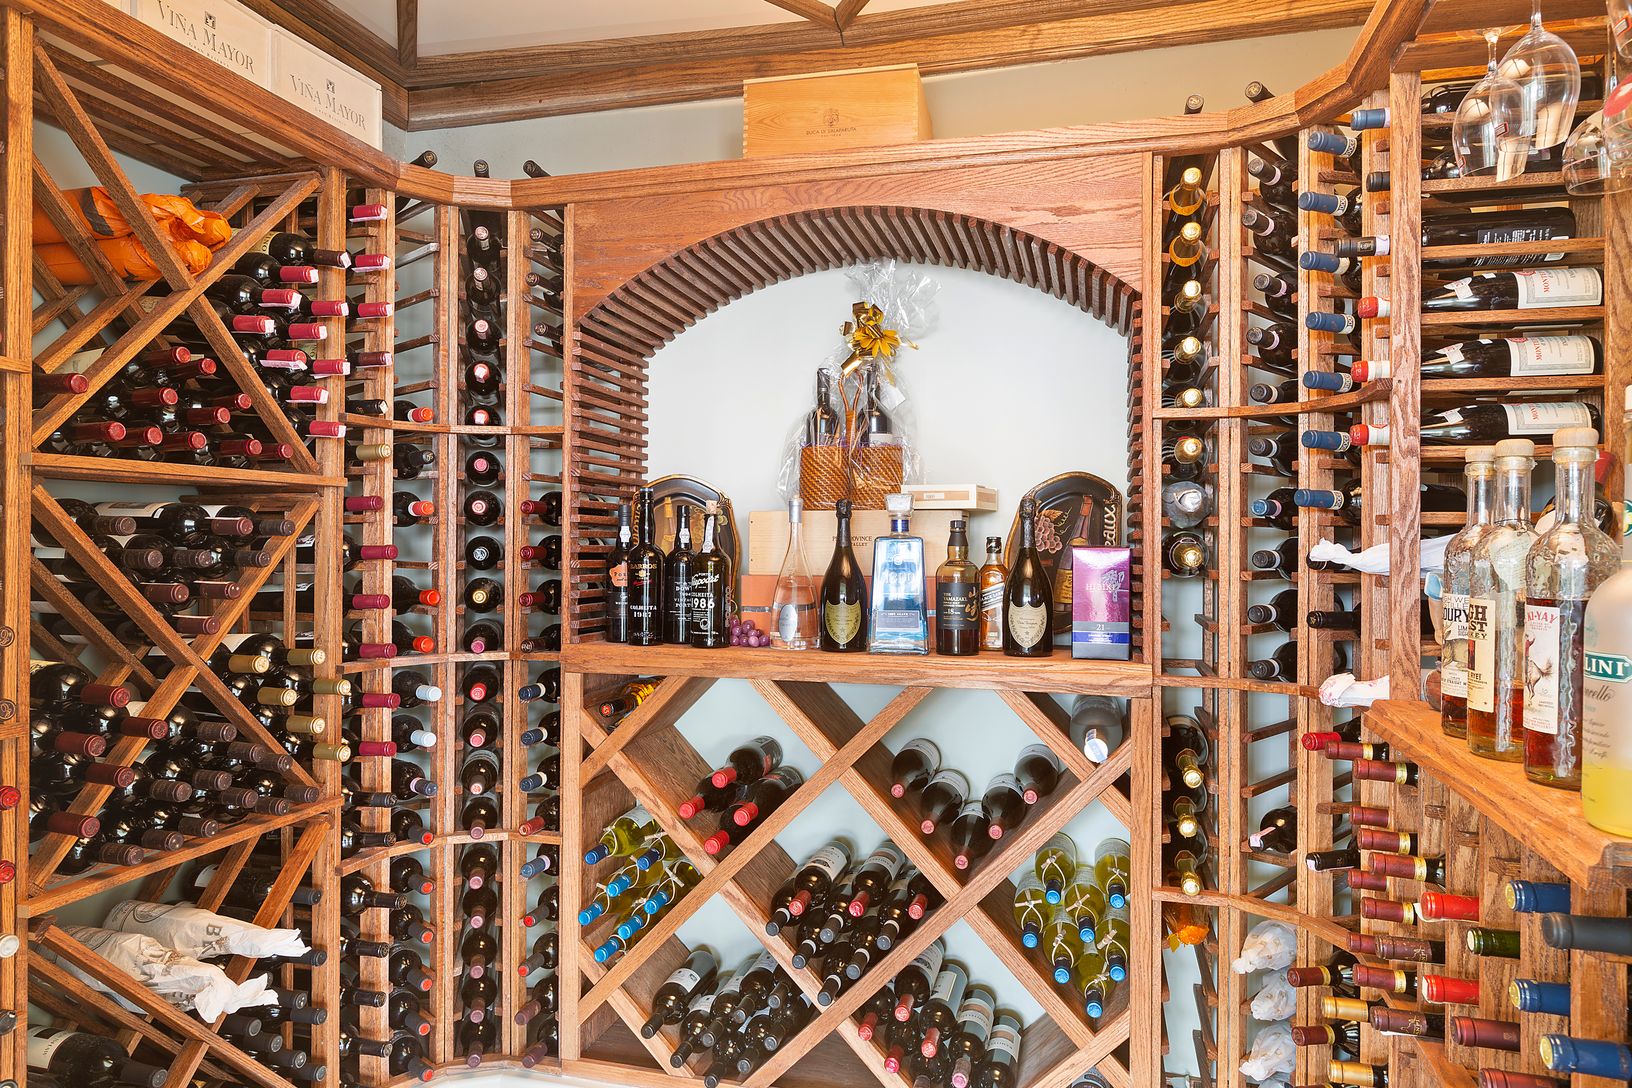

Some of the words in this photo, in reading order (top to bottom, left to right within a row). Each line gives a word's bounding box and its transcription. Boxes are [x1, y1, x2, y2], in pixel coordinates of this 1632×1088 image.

[156, 0, 197, 41] VIÑA
[202, 28, 255, 75] MAYOR
[290, 73, 321, 105] VIÑA
[325, 93, 368, 131] MAYOR
[1103, 504, 1116, 546] eaux
[691, 598, 716, 609] 1986
[1584, 656, 1624, 676] LINI
